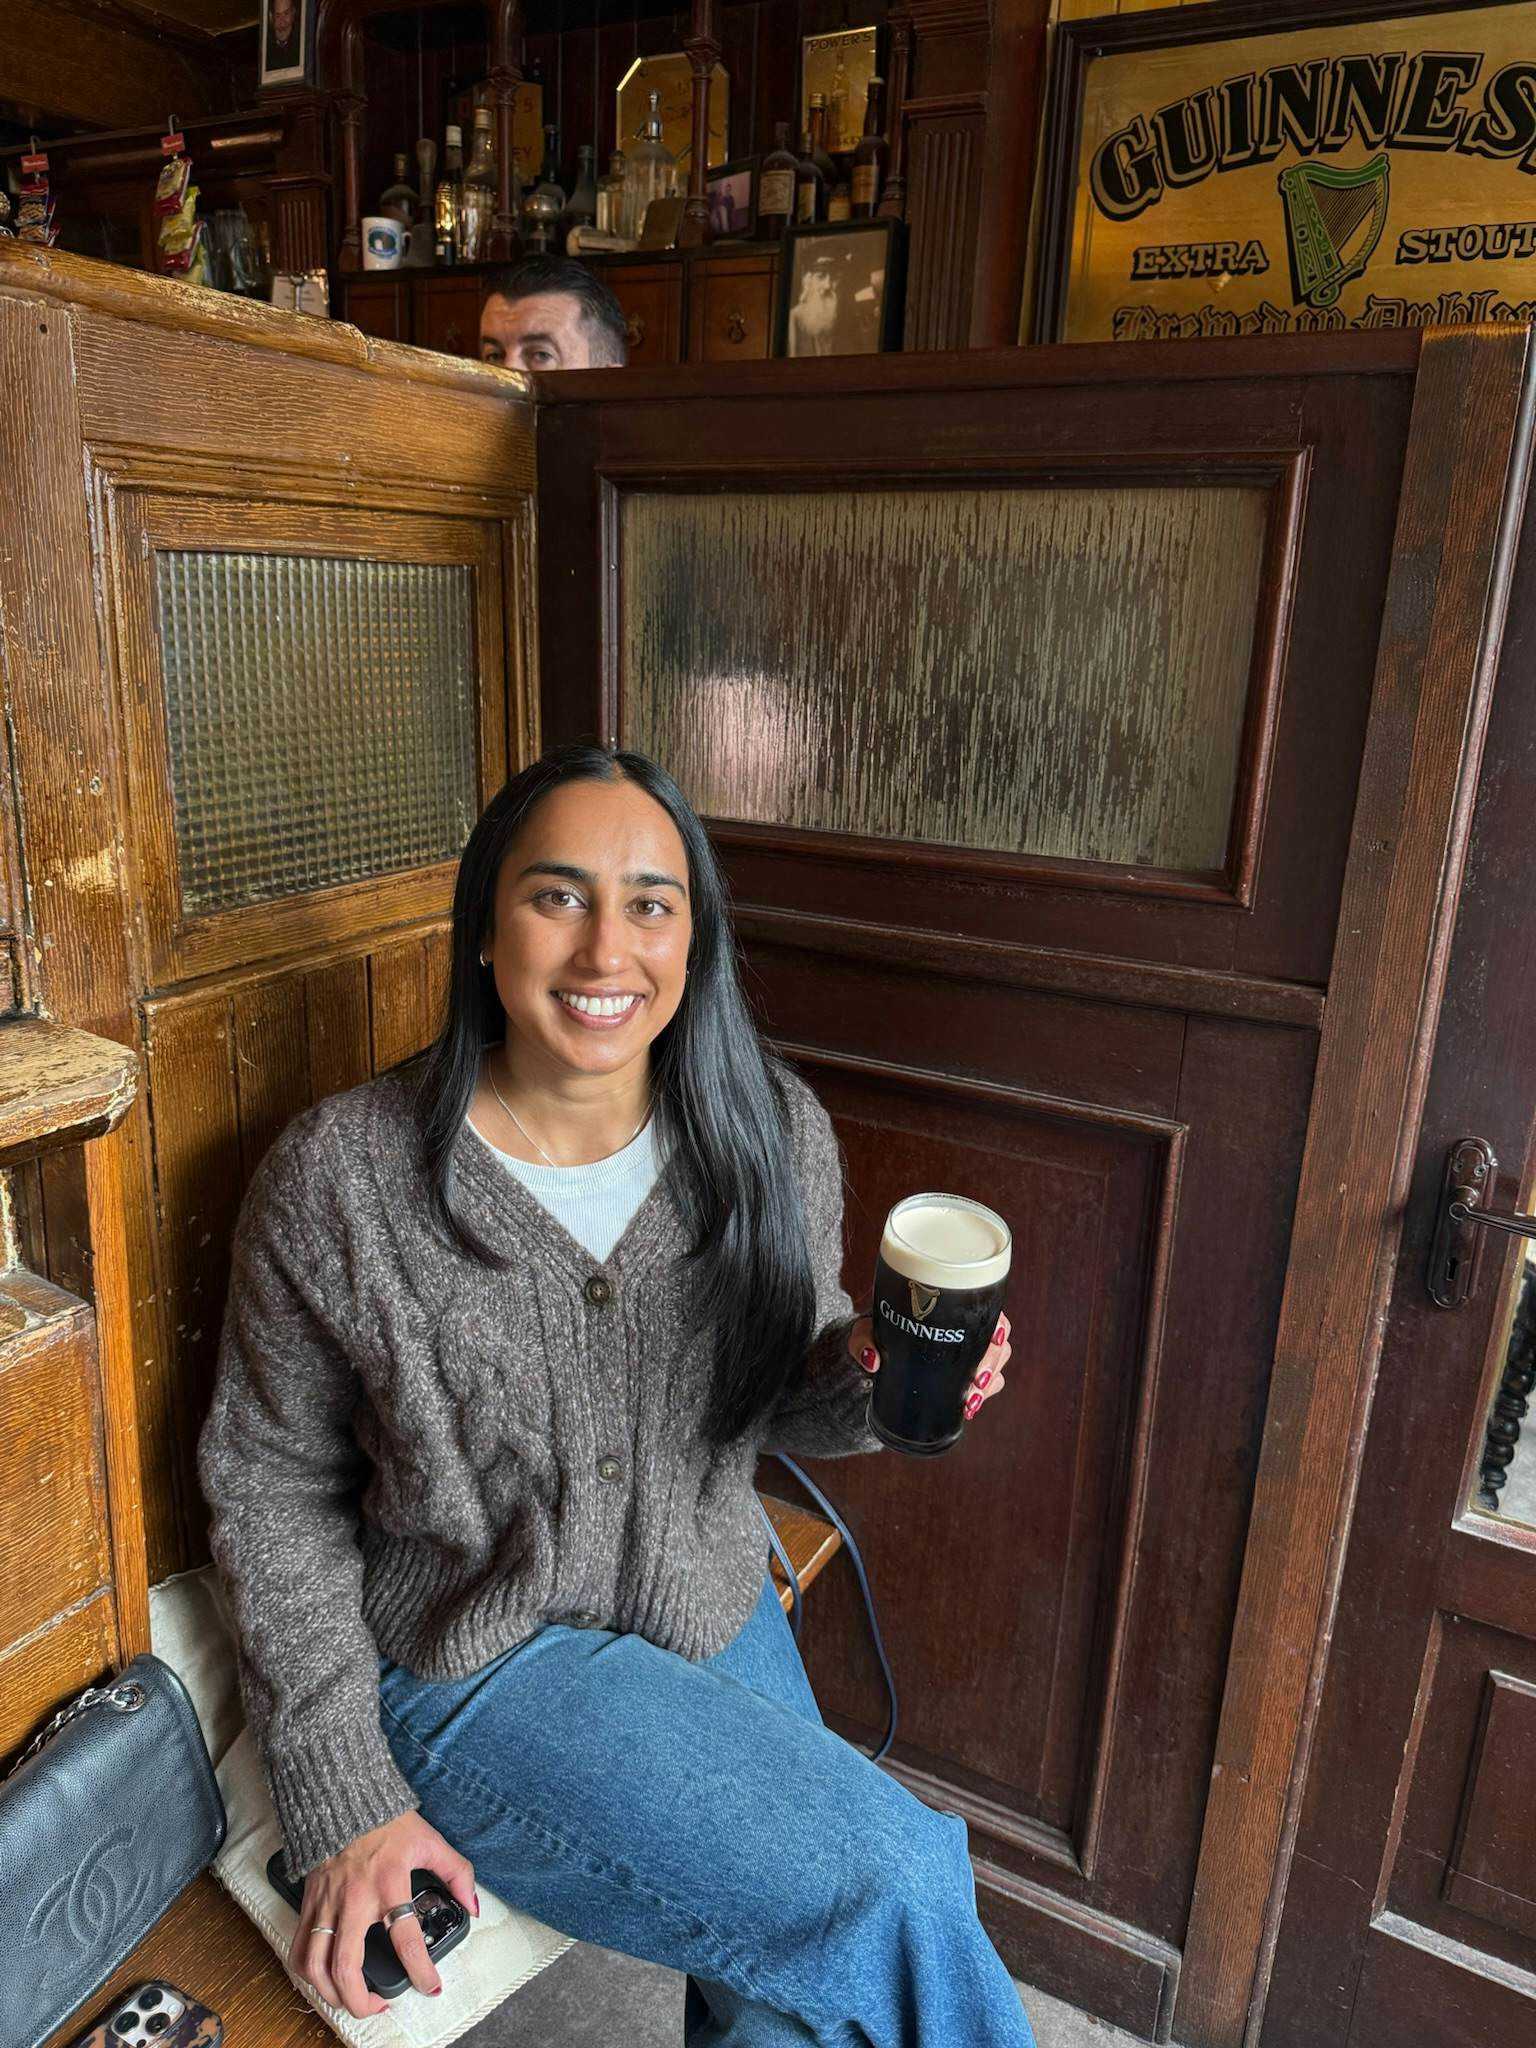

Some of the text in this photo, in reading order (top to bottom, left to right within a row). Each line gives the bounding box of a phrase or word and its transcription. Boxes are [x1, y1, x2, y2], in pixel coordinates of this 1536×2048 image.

[1090, 51, 1536, 221] GUINNES
[1131, 222, 1536, 280] EXTRA STOUT
[879, 1300, 966, 1343] GUINNESS
